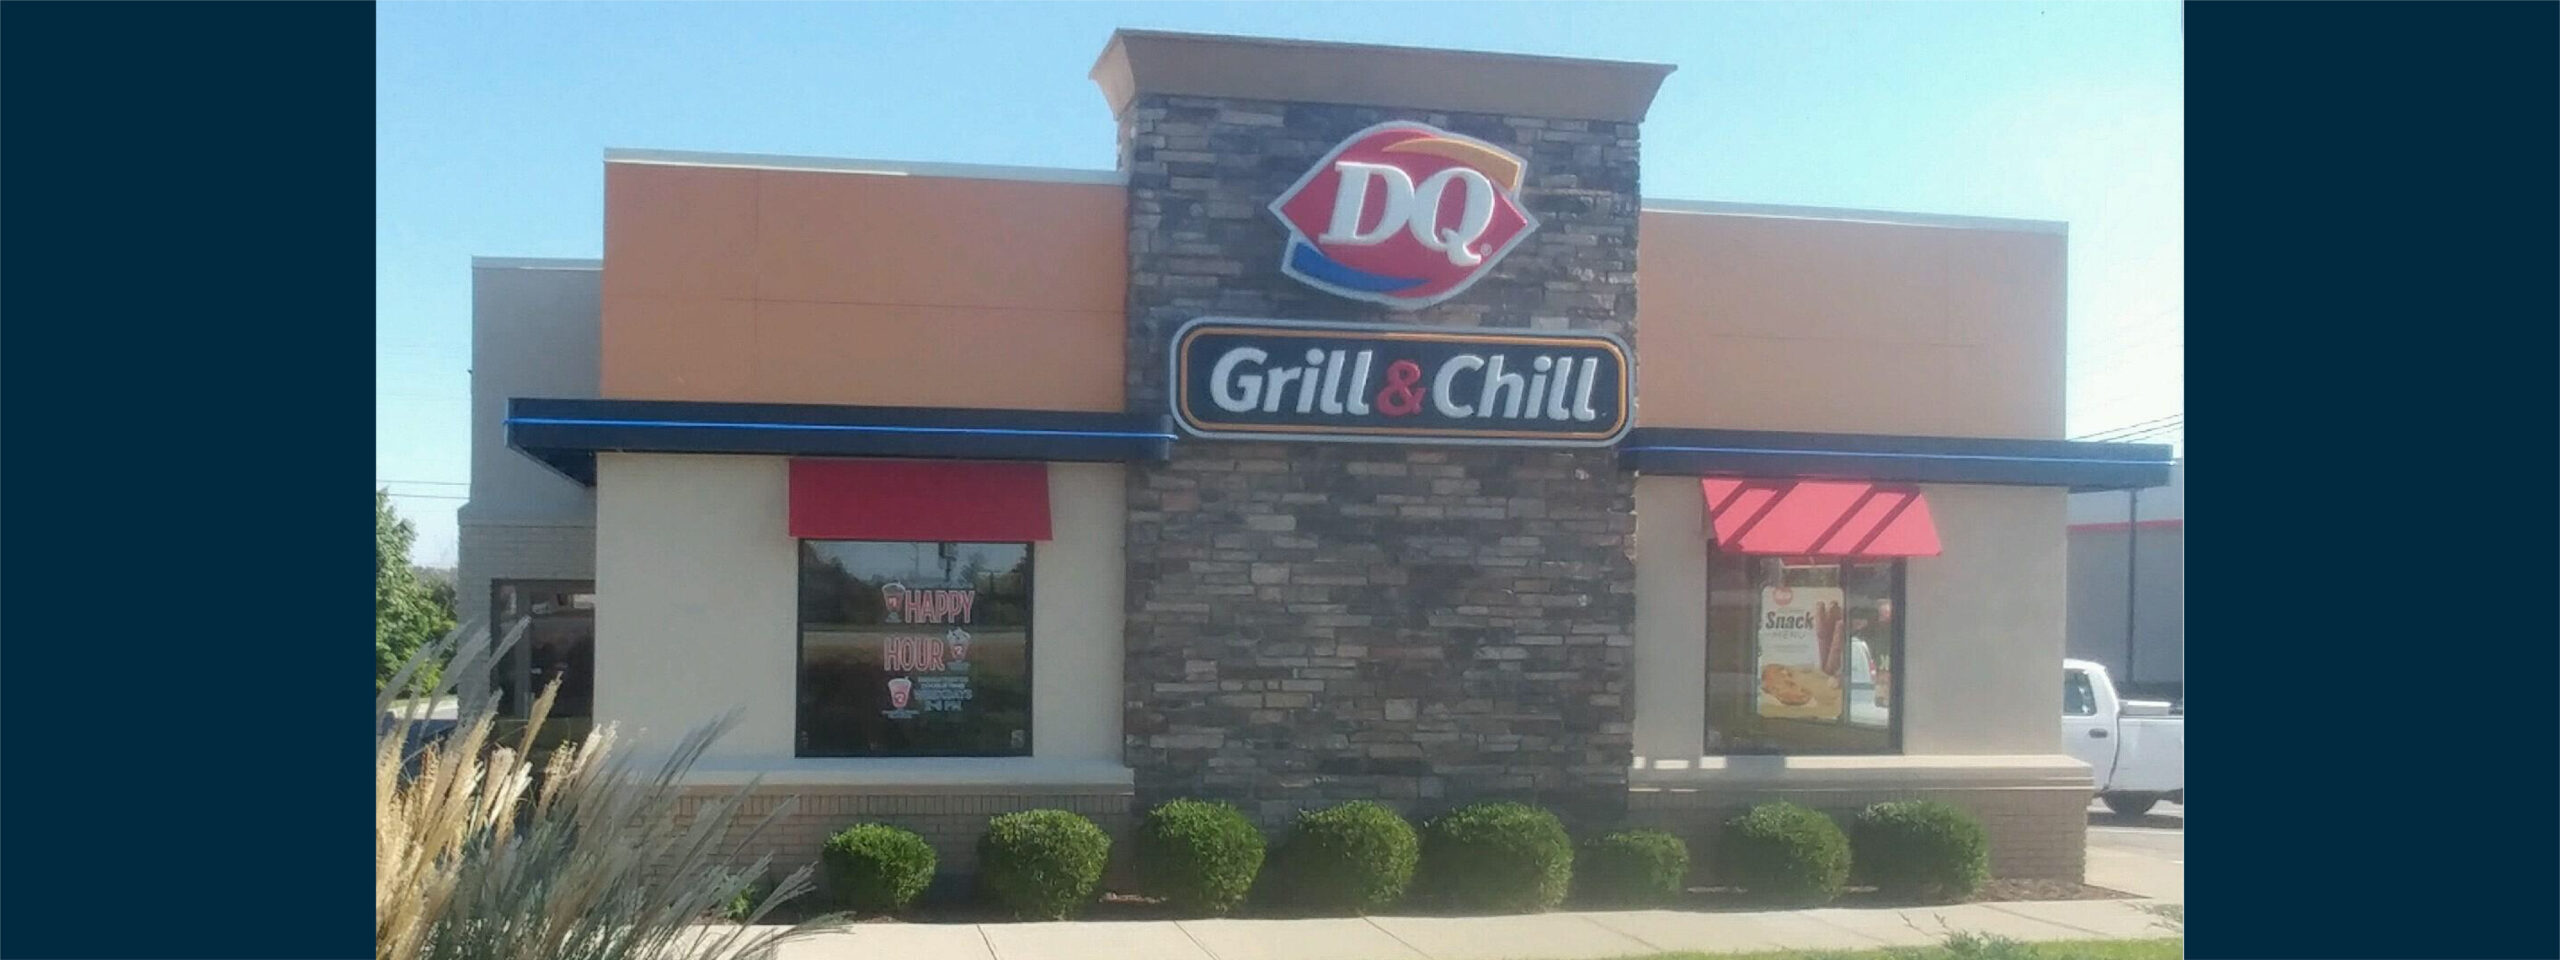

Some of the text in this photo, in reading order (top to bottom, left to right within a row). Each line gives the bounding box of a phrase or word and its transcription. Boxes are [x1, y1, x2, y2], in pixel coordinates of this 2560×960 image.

[1319, 161, 1495, 266] DQ
[1210, 347, 1598, 420] Grill & Chill
[905, 590, 975, 623] HAPPY
[1765, 611, 1814, 629] Snack
[883, 637, 945, 671] HOUR
